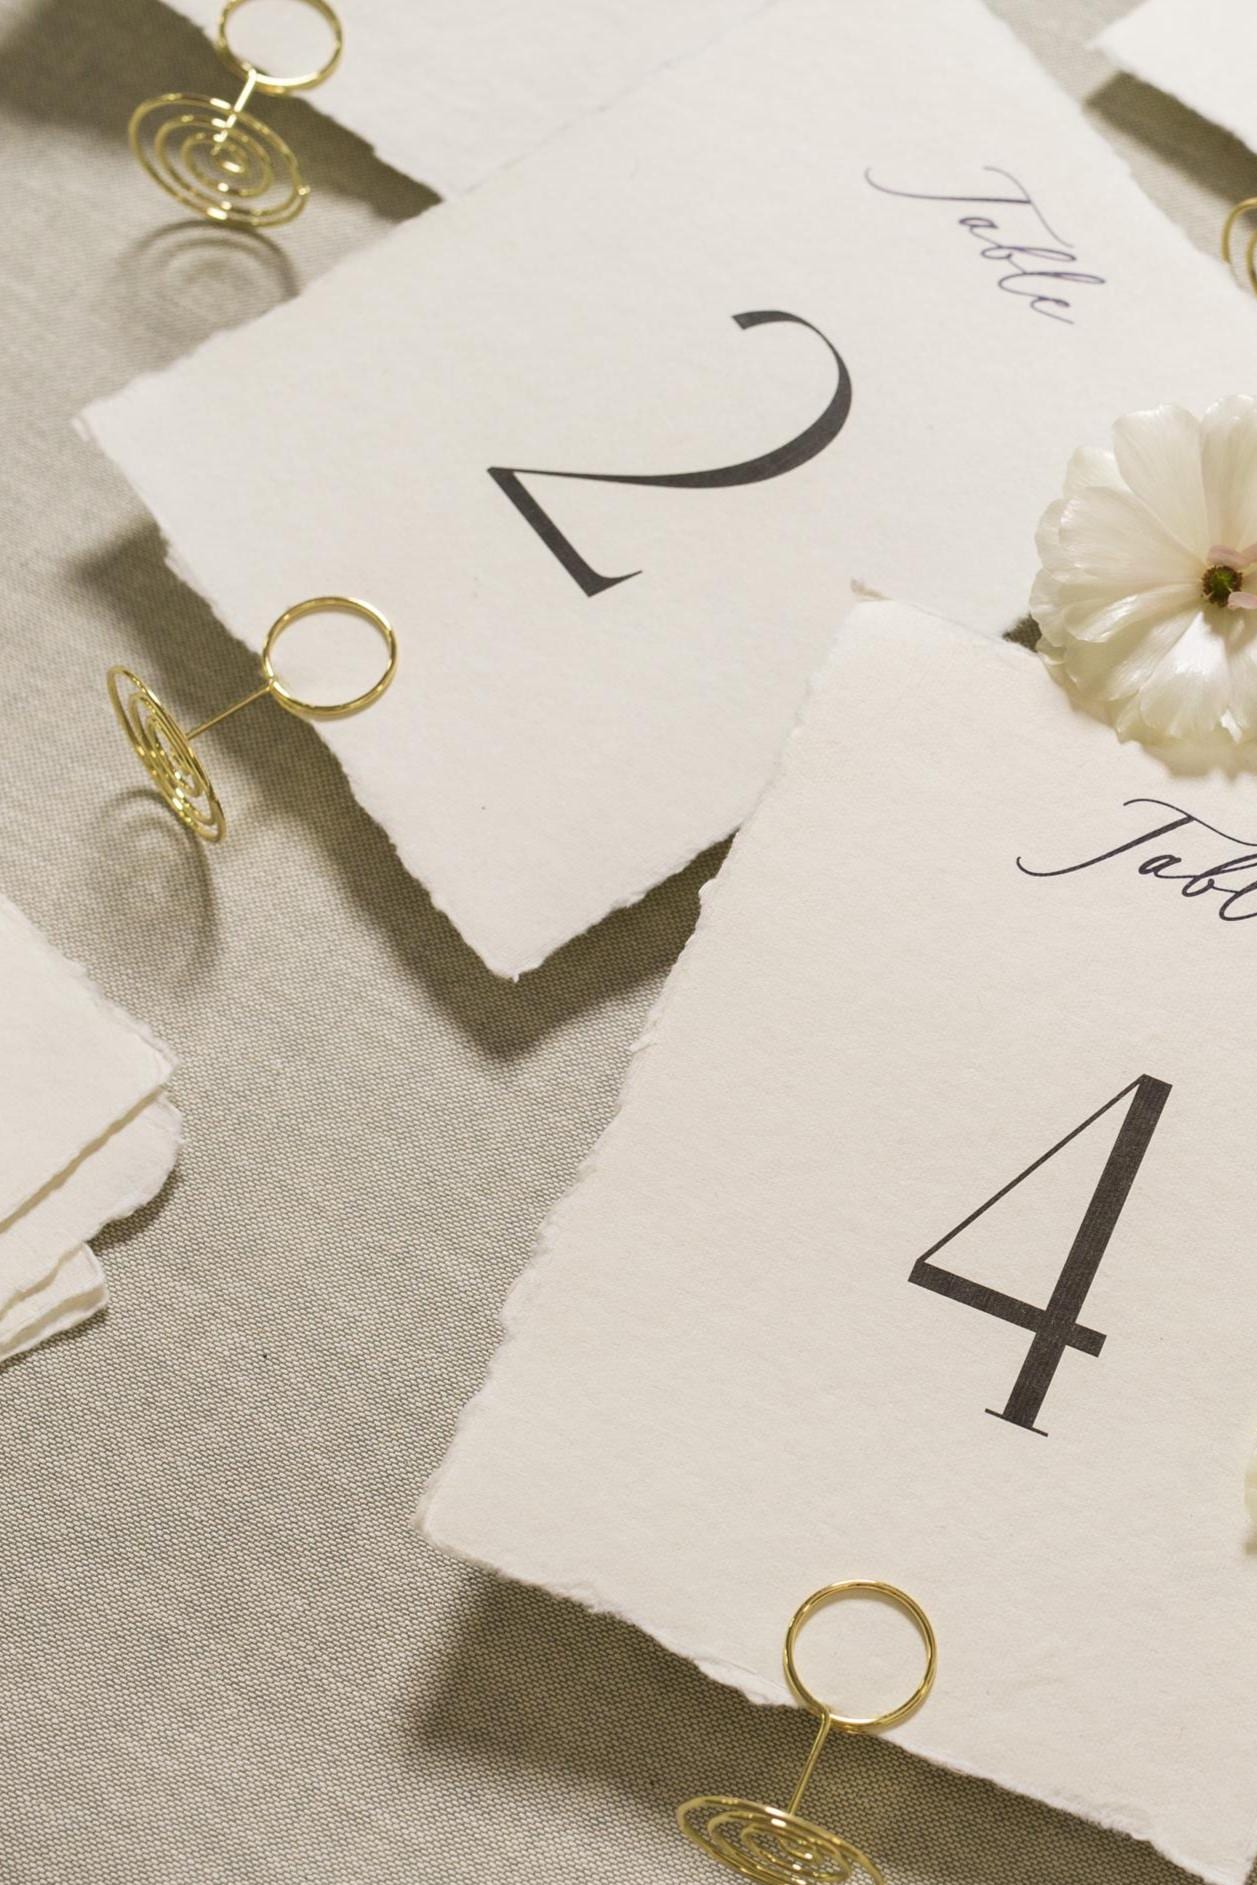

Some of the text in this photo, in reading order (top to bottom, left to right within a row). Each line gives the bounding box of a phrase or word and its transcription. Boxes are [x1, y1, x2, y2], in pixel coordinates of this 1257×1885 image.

[864, 165, 1107, 325] Table
[486, 309, 853, 599] 2
[907, 1073, 1174, 1438] 4
